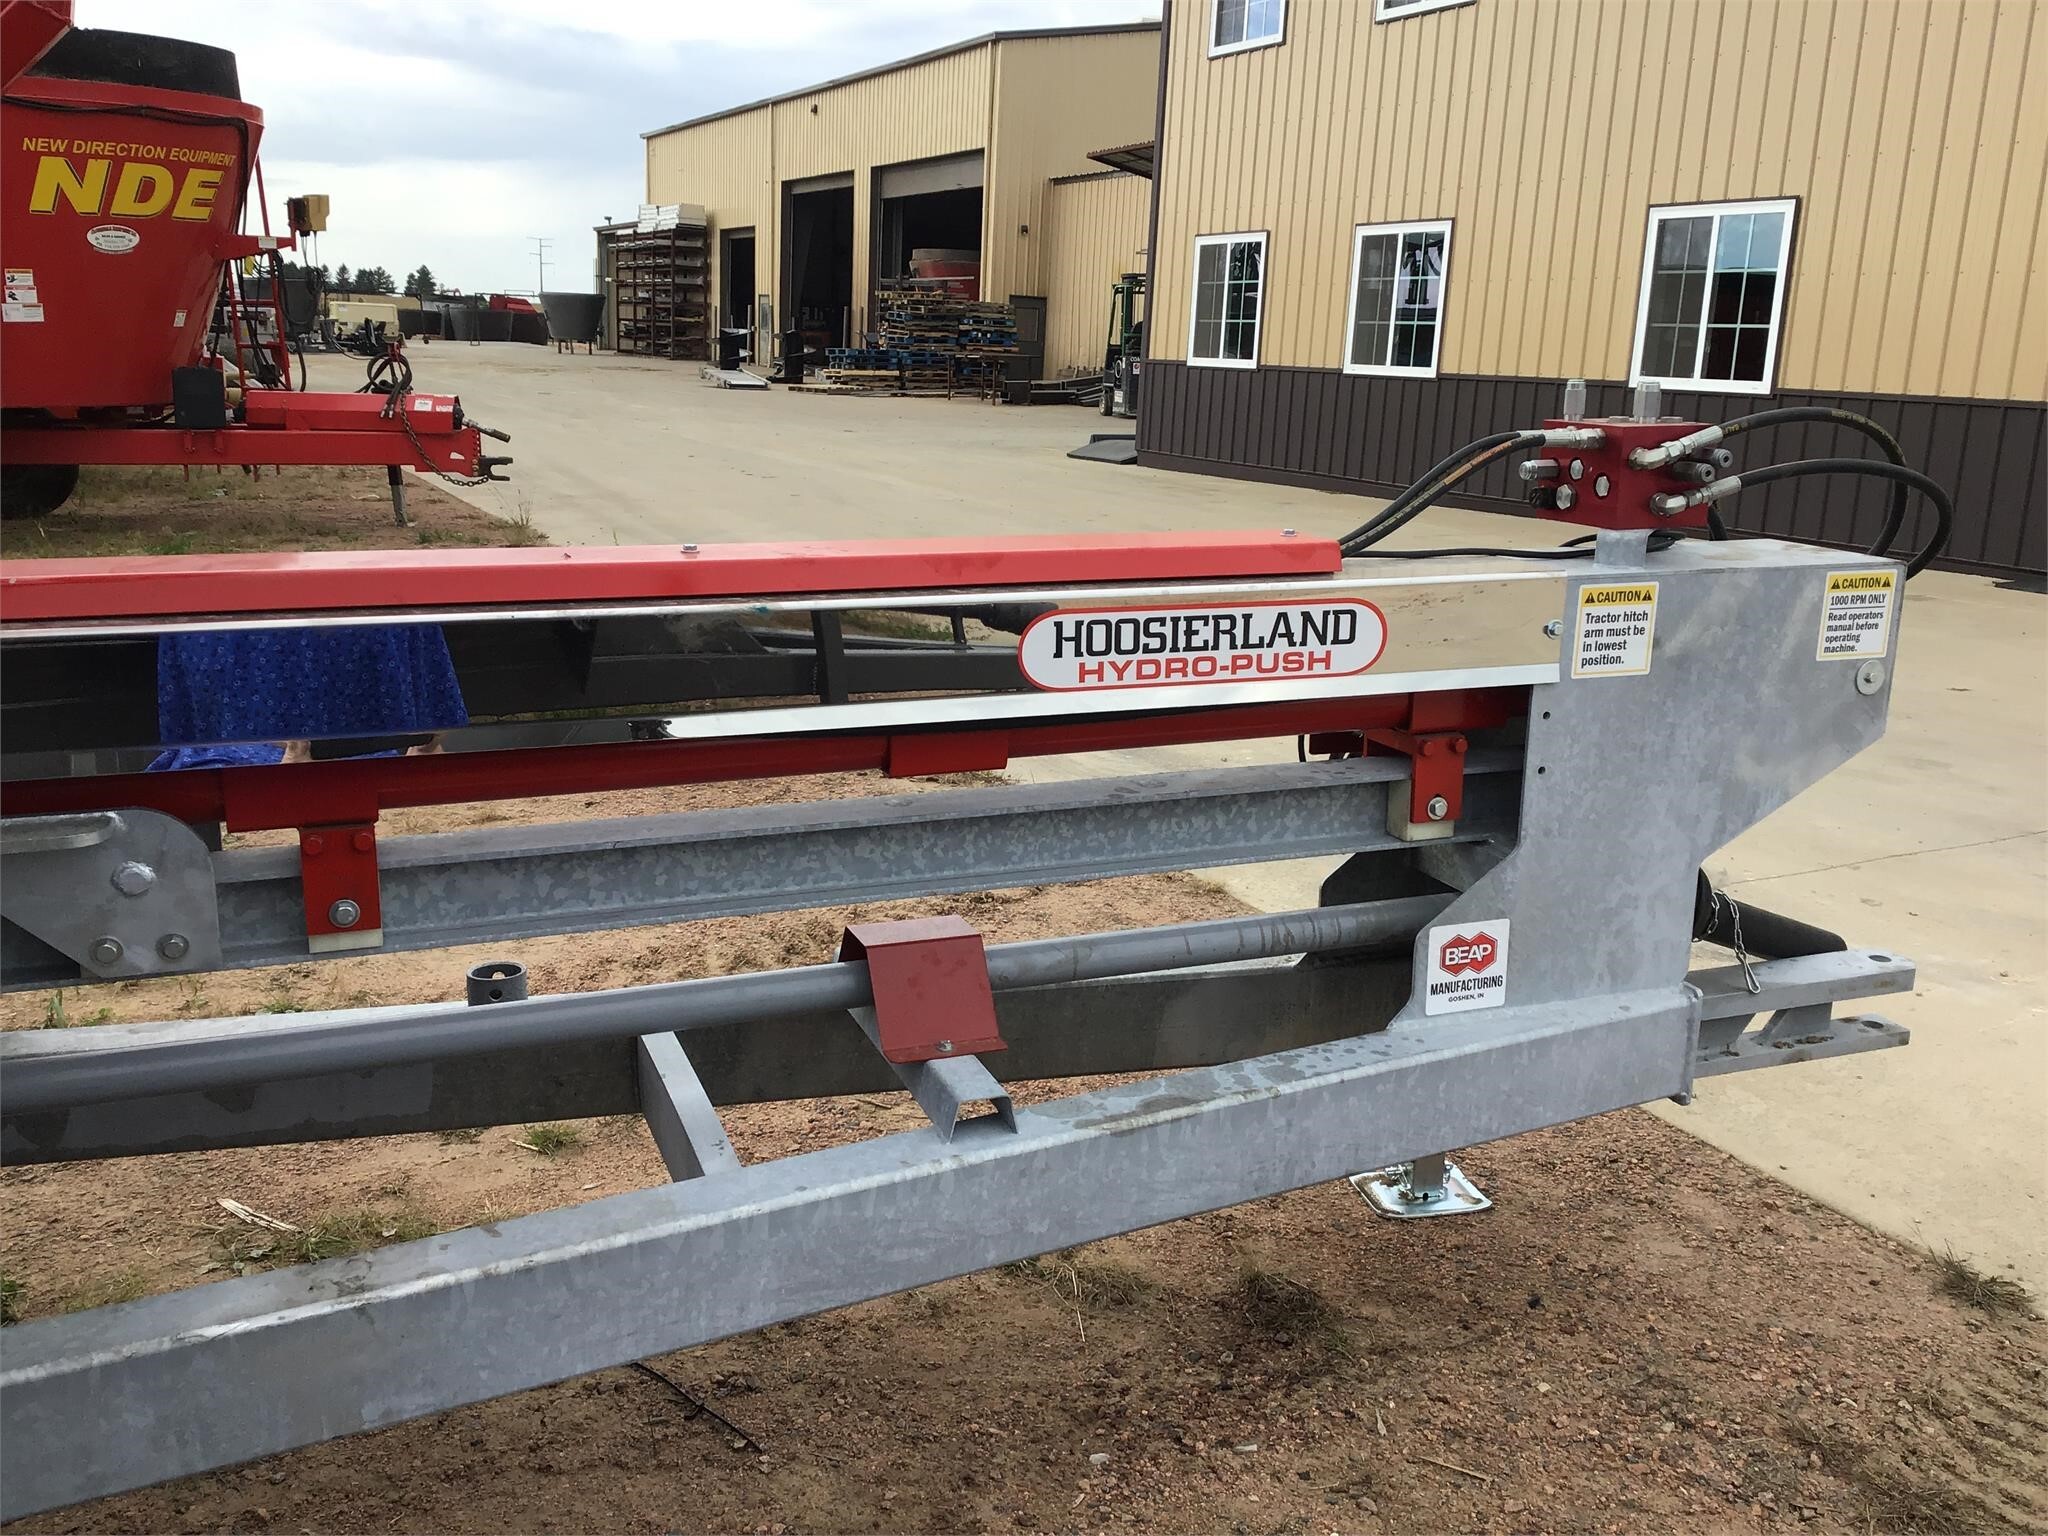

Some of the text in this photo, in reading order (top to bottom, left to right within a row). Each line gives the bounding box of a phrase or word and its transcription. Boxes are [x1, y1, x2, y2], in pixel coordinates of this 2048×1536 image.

[22, 137, 237, 167] NEW DIRECTION EQUIPMENT
[30, 155, 225, 223] NDE
[1842, 577, 1882, 589] CAUTION
[1596, 590, 1641, 603] CAUTION
[1830, 593, 1887, 606] 1000 RPM ONLY
[1585, 610, 1649, 624] Tractor hitch
[1828, 610, 1884, 622] Read operators
[1584, 624, 1646, 638] arm must be
[1826, 621, 1879, 632] manual before
[1052, 608, 1358, 659] HOOSIERLAND
[1825, 633, 1861, 644] operating
[1582, 639, 1627, 652] in lowest
[1823, 643, 1858, 653] machine.
[1078, 650, 1332, 684] HYDRO-PUSH
[1581, 653, 1625, 669] position.
[1445, 944, 1492, 966] BEAP
[1430, 975, 1504, 996] MANUFACTURING
[1448, 994, 1476, 1002] GOSHEN,
